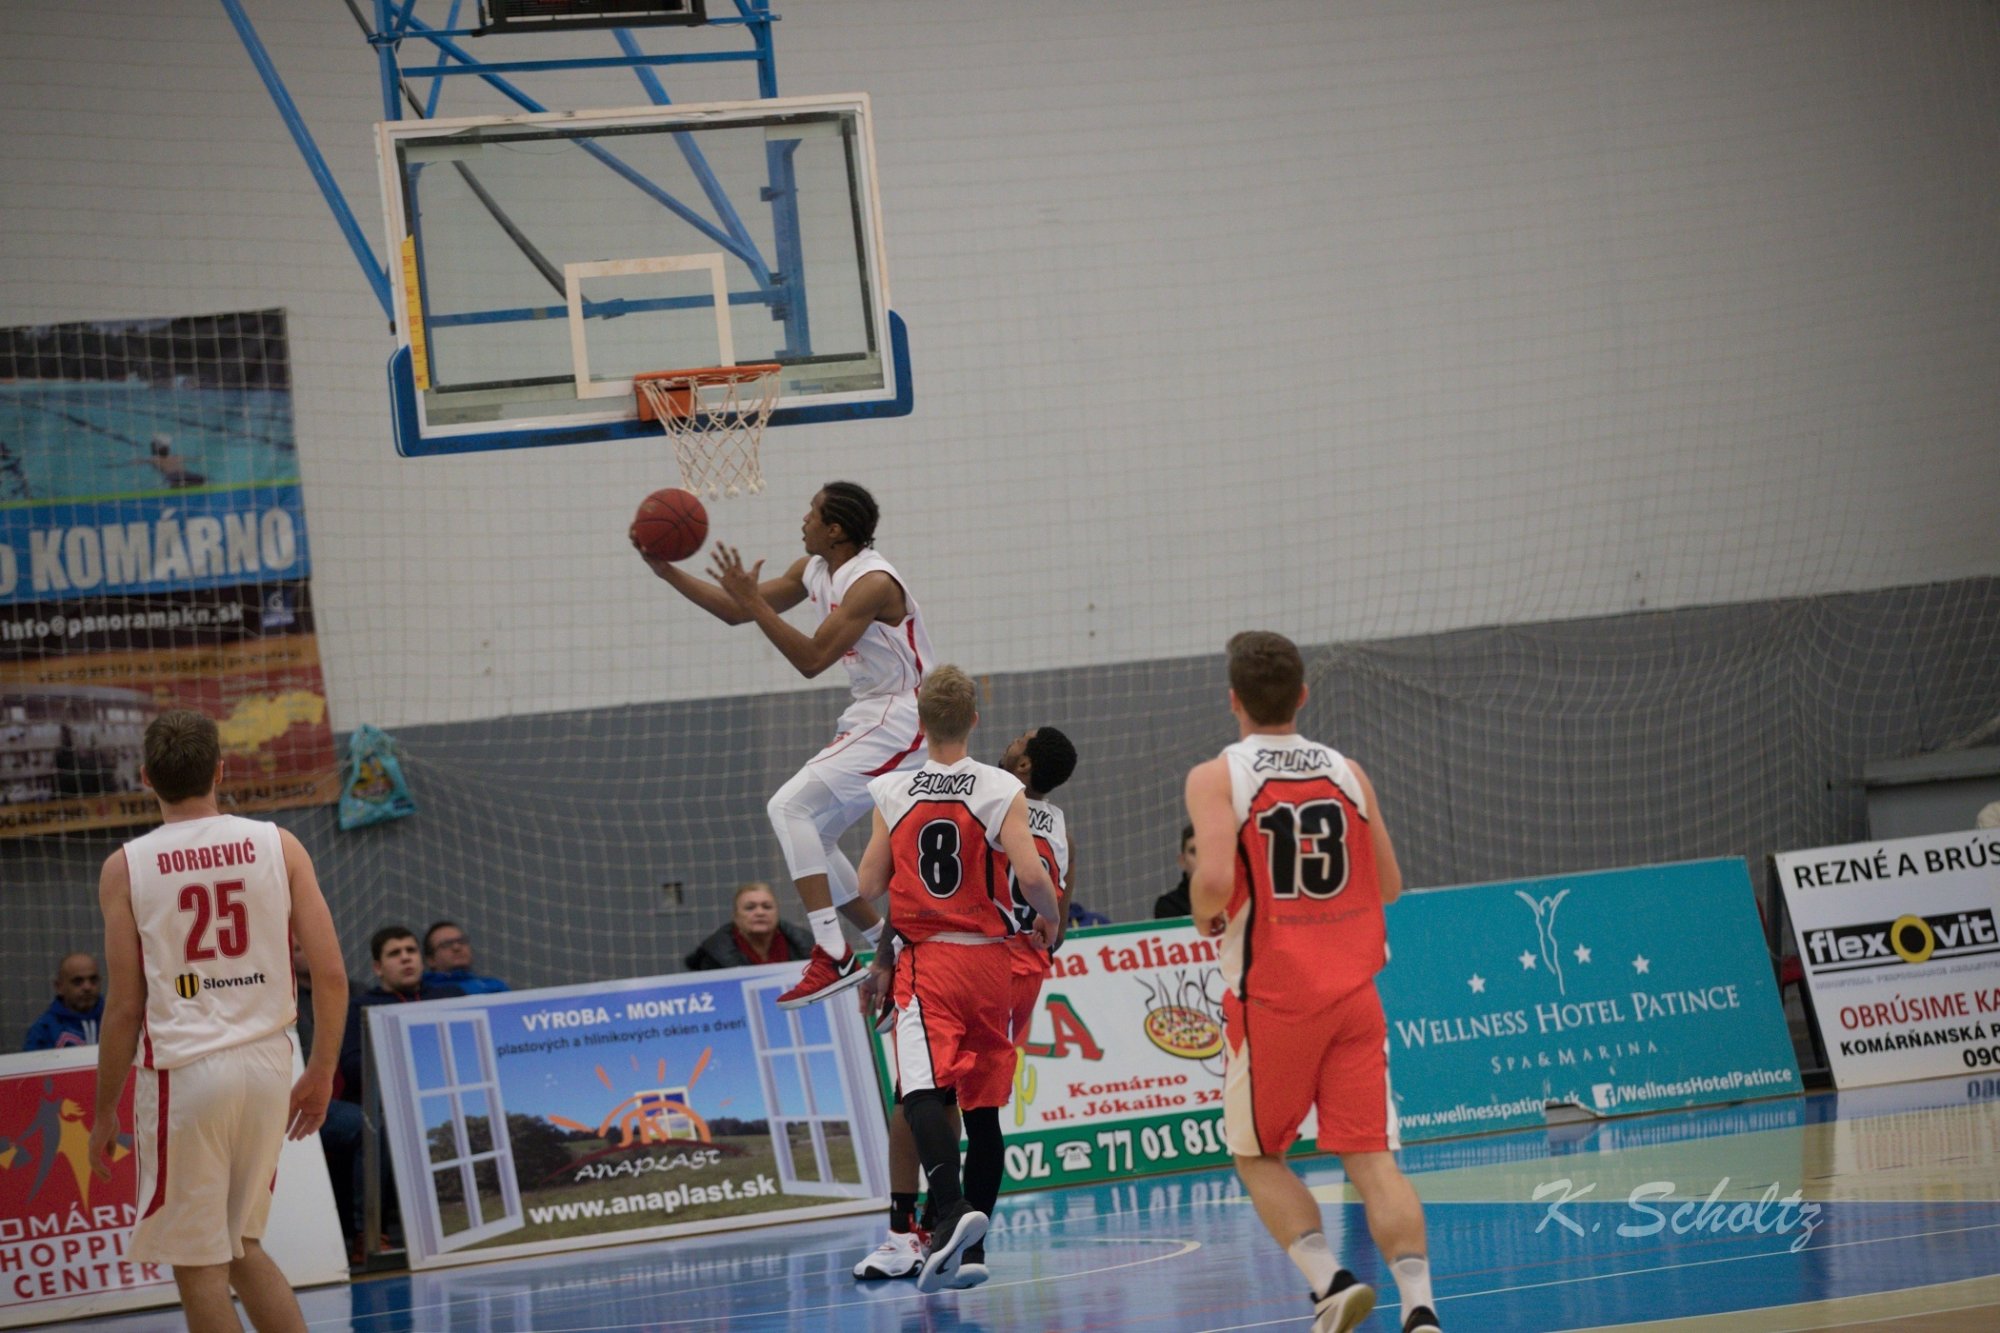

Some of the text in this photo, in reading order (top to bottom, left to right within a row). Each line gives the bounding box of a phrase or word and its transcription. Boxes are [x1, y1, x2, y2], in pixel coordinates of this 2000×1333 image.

[29, 507, 296, 593] KOMÁRNO
[1028, 807, 1054, 833] NA
[157, 838, 256, 875] ĐORĐEVIĆ
[917, 817, 963, 899] 8
[1256, 798, 1348, 900] 13
[1793, 837, 2000, 889] REZNÉ A BRÚS
[178, 878, 250, 964] 25
[203, 972, 266, 990] Slovnaft
[522, 1007, 611, 1032] VÝROBA
[626, 992, 716, 1021] MONTÁŽ
[1395, 984, 1741, 1049] WELLNESS HOTEL PATINCE
[1839, 994, 1970, 1030] OBRÚSIME
[1067, 1072, 1188, 1098] Komárno
[1041, 1107, 1075, 1123] ul.
[1082, 1093, 1188, 1118] Jókaiho
[1003, 1140, 1052, 1182] OZ
[1096, 1129, 1135, 1173] 77
[1141, 1125, 1179, 1161] 01
[529, 1174, 777, 1225] www.anaplast.sk
[0, 1232, 128, 1272] HOPPI
[14, 1261, 162, 1298] CENTER
